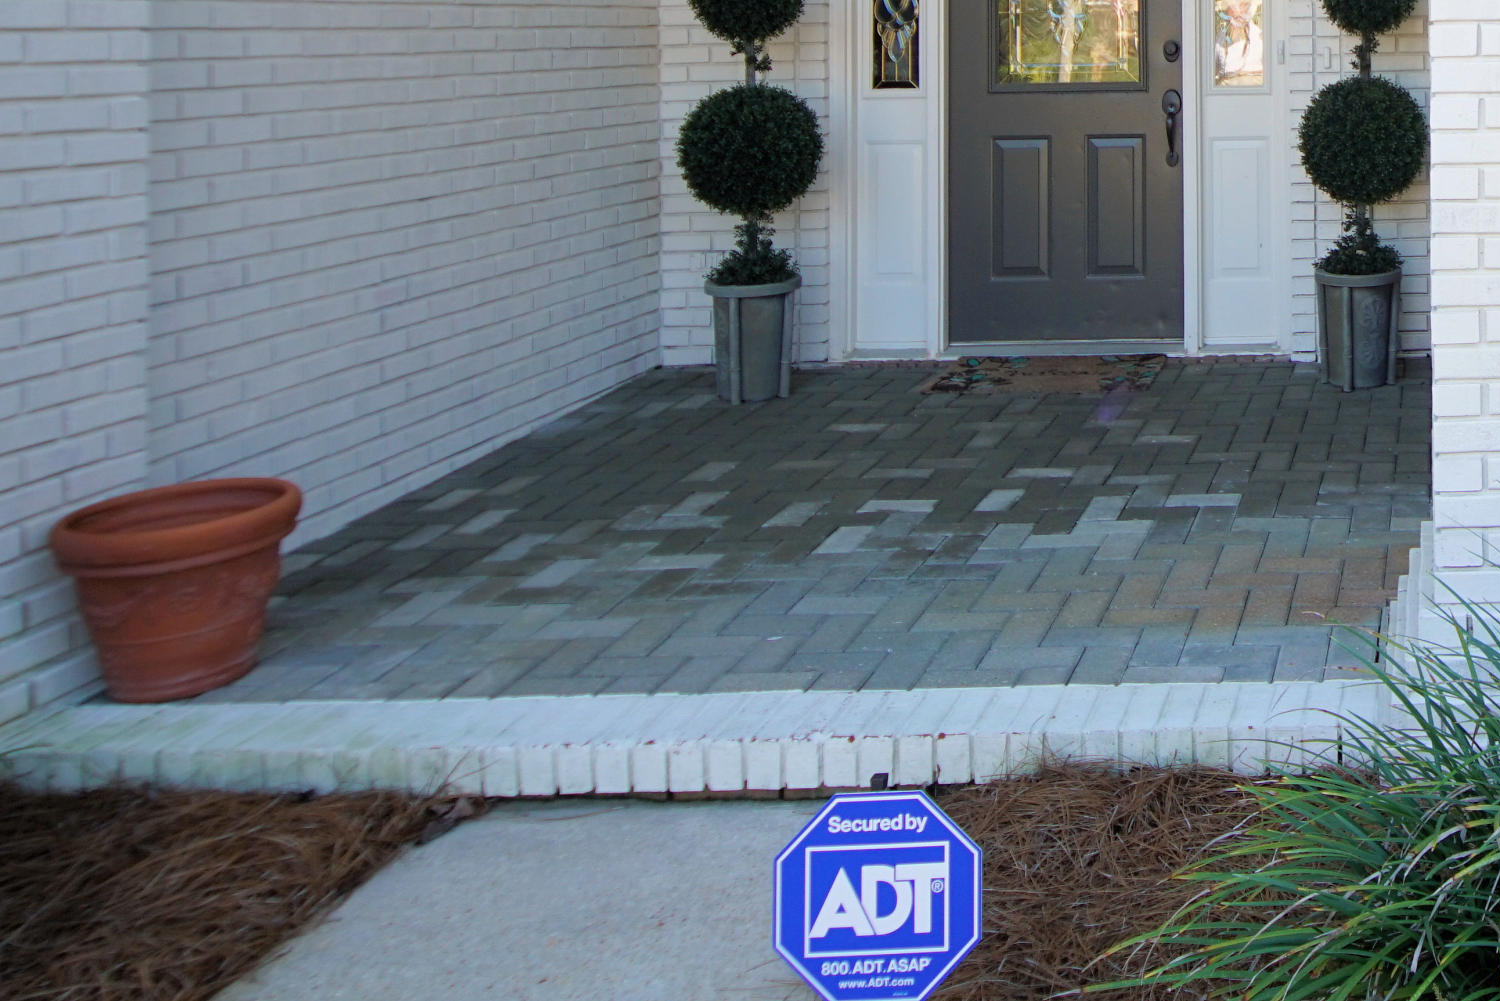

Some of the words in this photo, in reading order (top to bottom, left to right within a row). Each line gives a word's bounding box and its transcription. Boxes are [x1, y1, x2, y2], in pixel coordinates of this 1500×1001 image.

[828, 813, 903, 833] Secured
[904, 813, 928, 833] by
[821, 958, 930, 976] 800.ADT.ASAP
[838, 977, 914, 989] www.ADT.com
